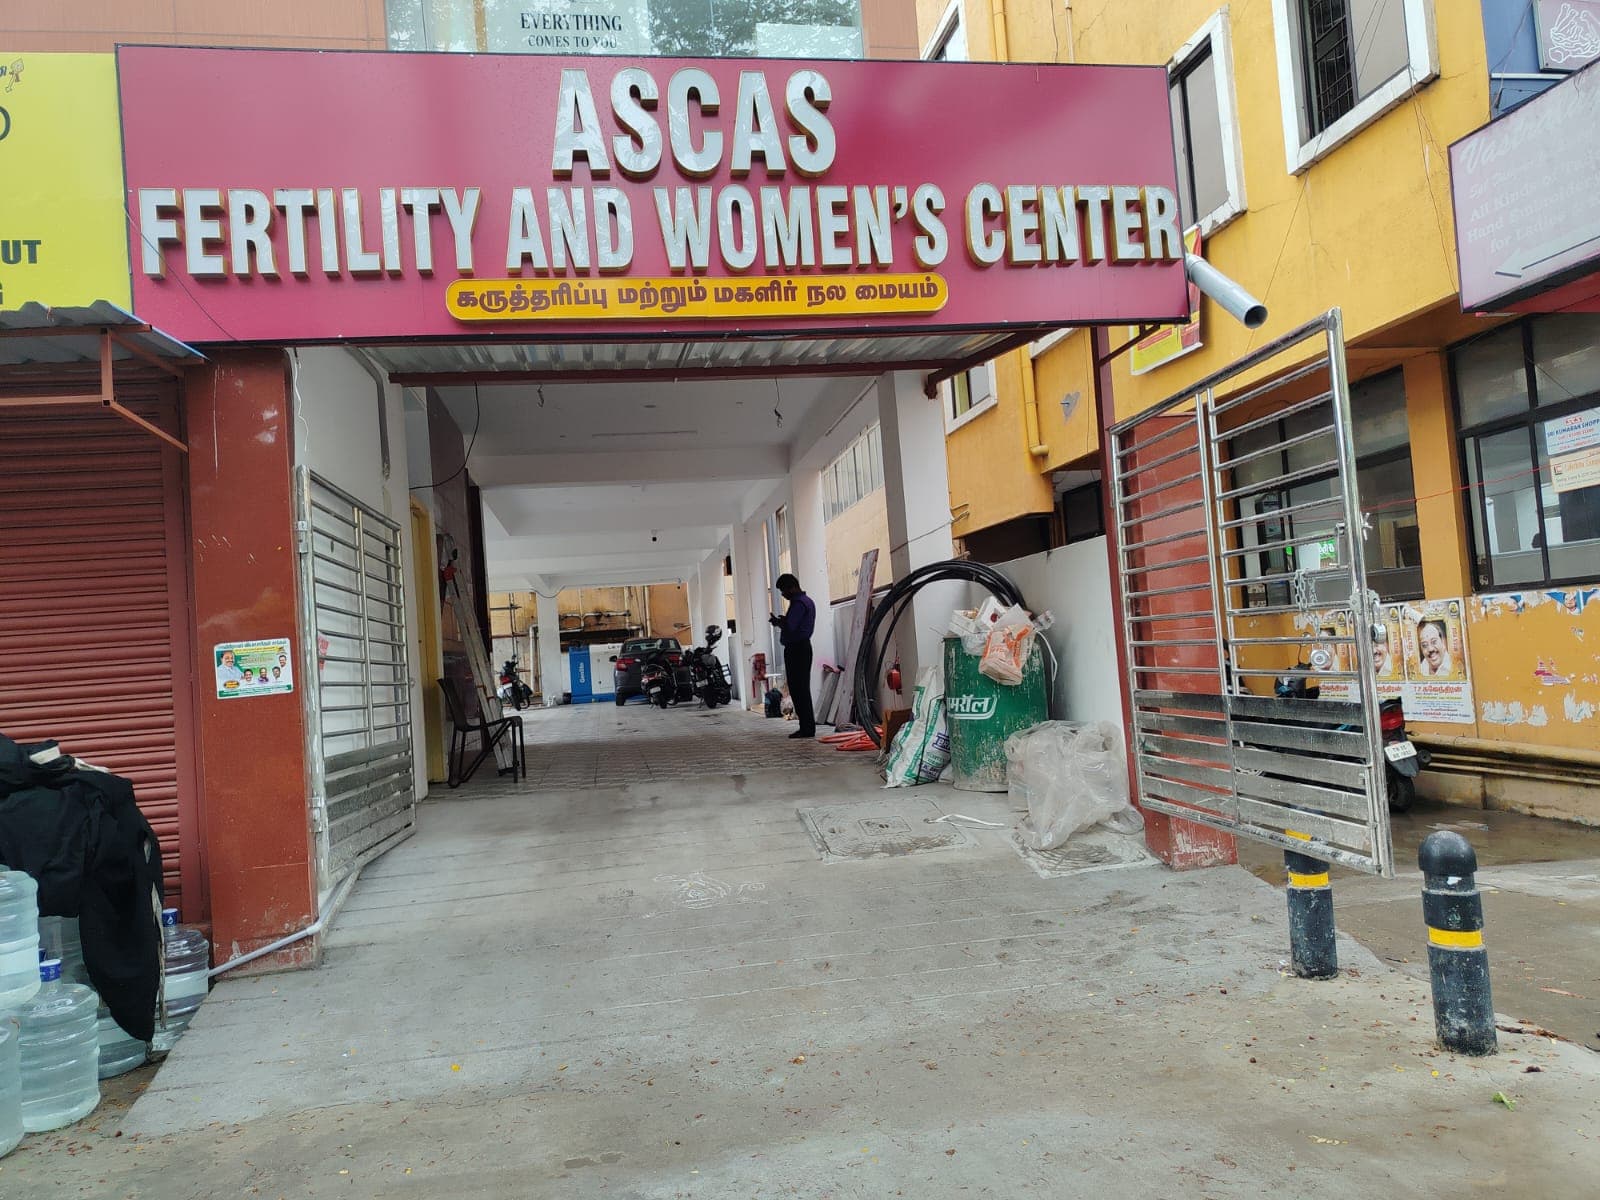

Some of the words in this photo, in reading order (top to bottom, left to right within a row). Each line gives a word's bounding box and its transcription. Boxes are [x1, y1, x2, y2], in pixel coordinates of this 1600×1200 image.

[520, 13, 622, 31] EVERYTHING
[528, 35, 570, 48] COMES
[572, 36, 590, 48] TO
[592, 36, 617, 48] YOU
[552, 66, 836, 178] ASCAS
[138, 186, 482, 280] FERTILITY
[506, 186, 635, 275] AND
[653, 182, 949, 272] WOMEN'S
[965, 182, 1181, 267] CENTER
[456, 282, 608, 313] கருத்தரிப்பு
[617, 279, 707, 313] மற்றும்
[714, 279, 799, 303] மகளிர்
[806, 284, 847, 307] நல
[855, 276, 939, 301] மையம்
